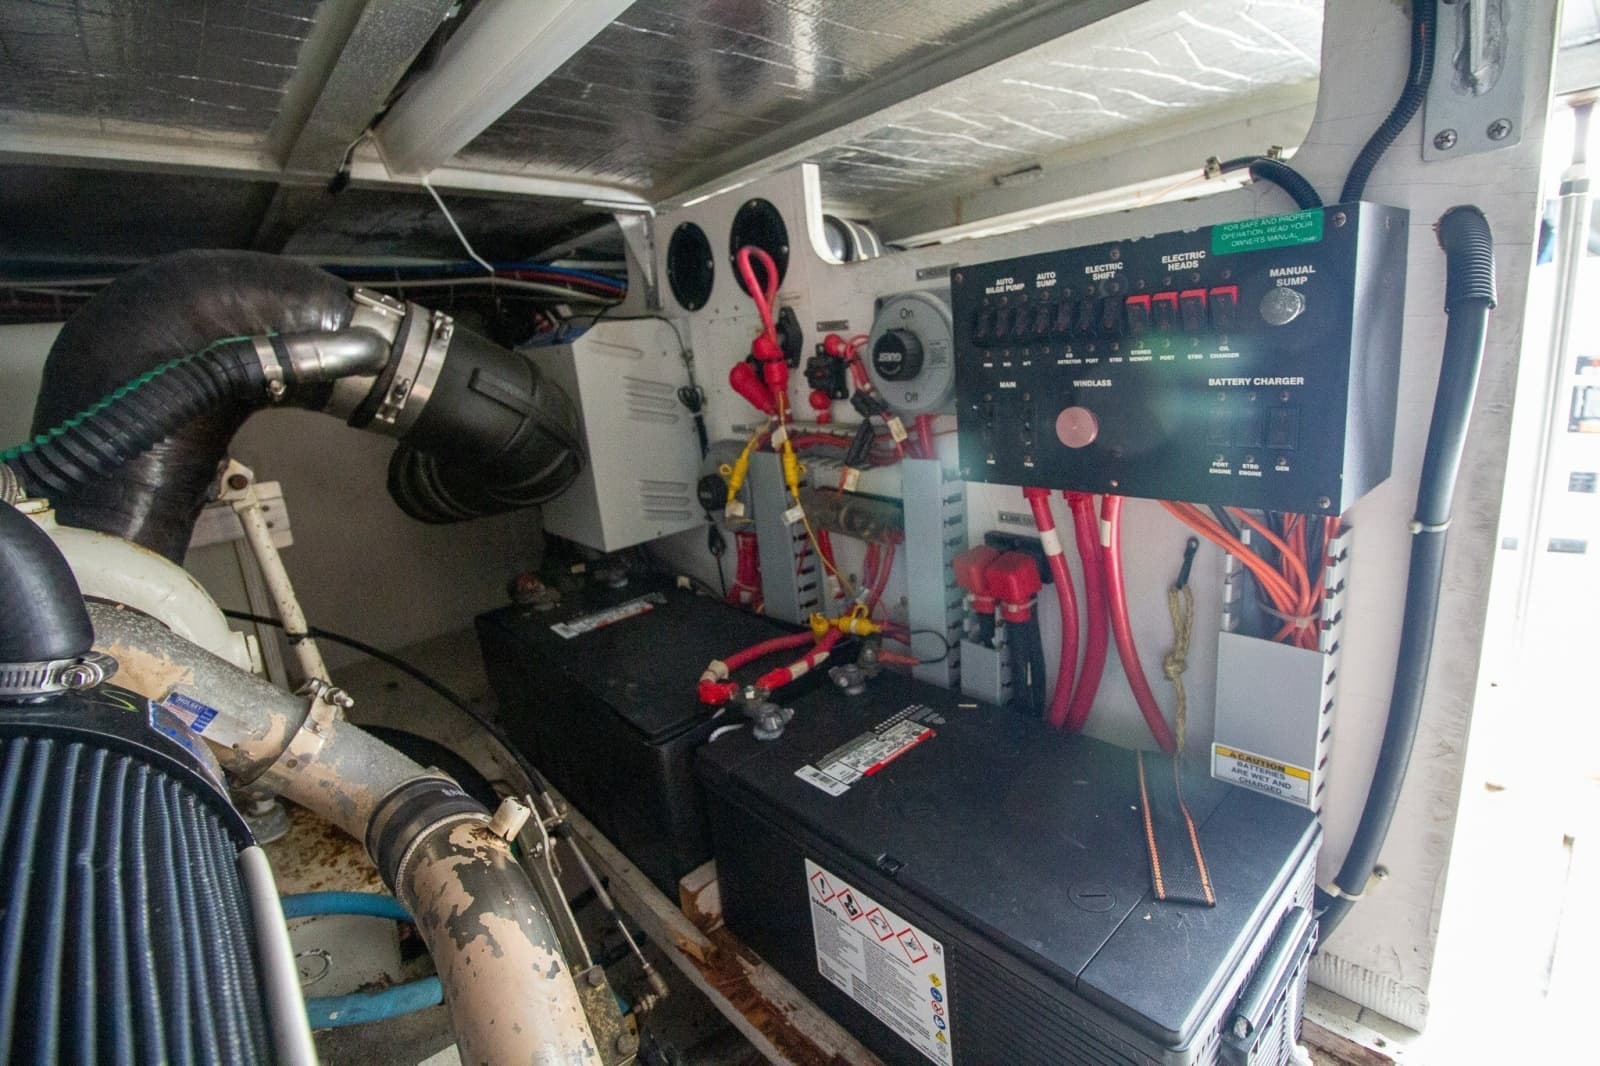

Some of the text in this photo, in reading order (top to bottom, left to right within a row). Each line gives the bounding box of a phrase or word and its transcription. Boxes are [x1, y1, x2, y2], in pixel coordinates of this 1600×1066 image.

[1224, 212, 1312, 232] FOR SAFE AND PROPER
[1267, 224, 1288, 233] READ
[1290, 221, 1313, 230] YOUR
[1162, 251, 1206, 264] ELECTRIC
[1085, 262, 1123, 274] ELECTRIC
[1168, 260, 1199, 271] HEADS
[1037, 272, 1056, 280] AUTO
[1092, 271, 1115, 281] SHIFT
[1269, 265, 1316, 278] MANUAL
[1036, 279, 1057, 288] SUMP
[1276, 276, 1308, 287] SUMP
[985, 283, 1025, 294] BILGE PUMP
[900, 308, 914, 319] On
[1073, 379, 1112, 387] WINDLASS
[1208, 376, 1304, 386] BATTERY CHARGER
[905, 392, 918, 402] Off
[1238, 752, 1285, 773] CAUTION
[1237, 761, 1286, 780] BATTERIES
[1231, 767, 1291, 789] ARE WET AND
[1239, 776, 1282, 794] CHARGED
